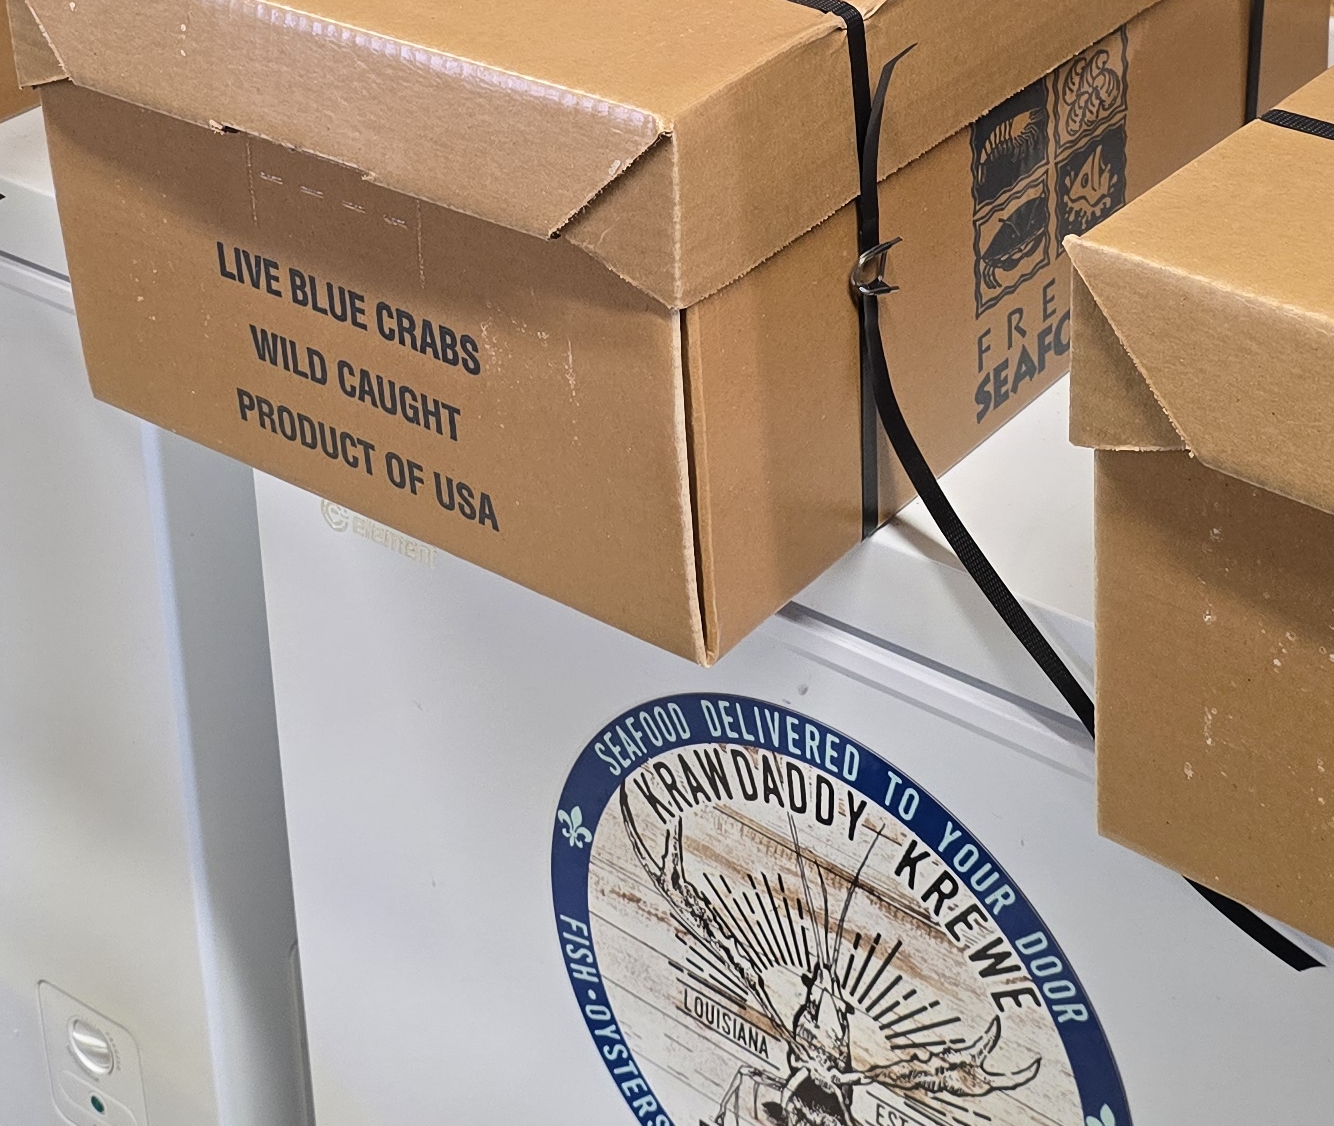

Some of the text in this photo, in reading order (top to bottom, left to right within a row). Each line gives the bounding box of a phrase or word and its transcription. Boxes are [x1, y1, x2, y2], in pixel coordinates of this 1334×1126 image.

[217, 241, 481, 375] LIVE BLUE CRABS
[249, 324, 461, 442] WILD CAUGHT
[236, 388, 500, 532] PRODUCT OF USA
[593, 698, 1090, 1024] SEAFOOD DELIVERED TO YOUR DOOR
[637, 747, 1042, 1015] KRAWDADDY KREWE
[559, 913, 671, 1126] FISH OYSTERS
[683, 988, 770, 1059] LOUISIANA
